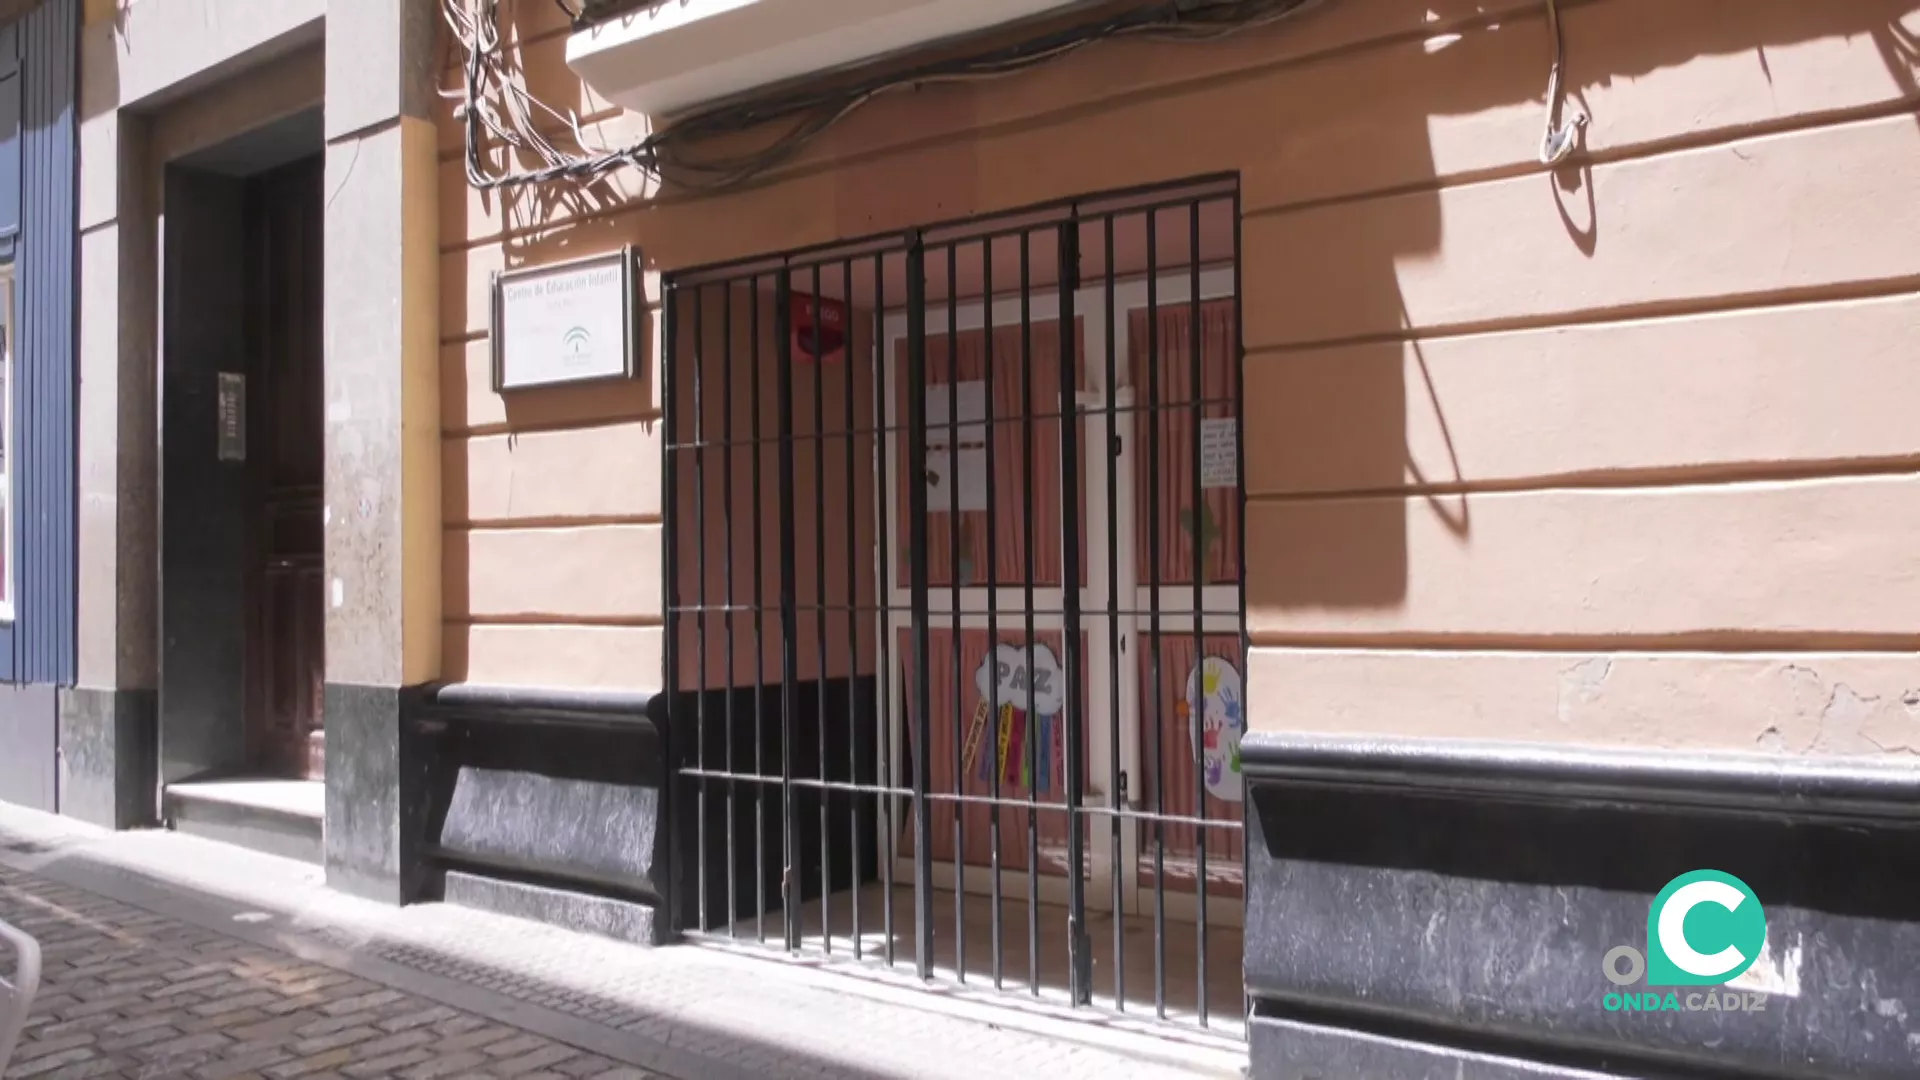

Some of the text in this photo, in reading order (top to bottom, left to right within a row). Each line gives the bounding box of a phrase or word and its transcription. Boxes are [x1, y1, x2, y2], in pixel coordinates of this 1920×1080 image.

[508, 268, 618, 302] Centro de Educación Infantil
[996, 661, 1052, 694] PAZ
